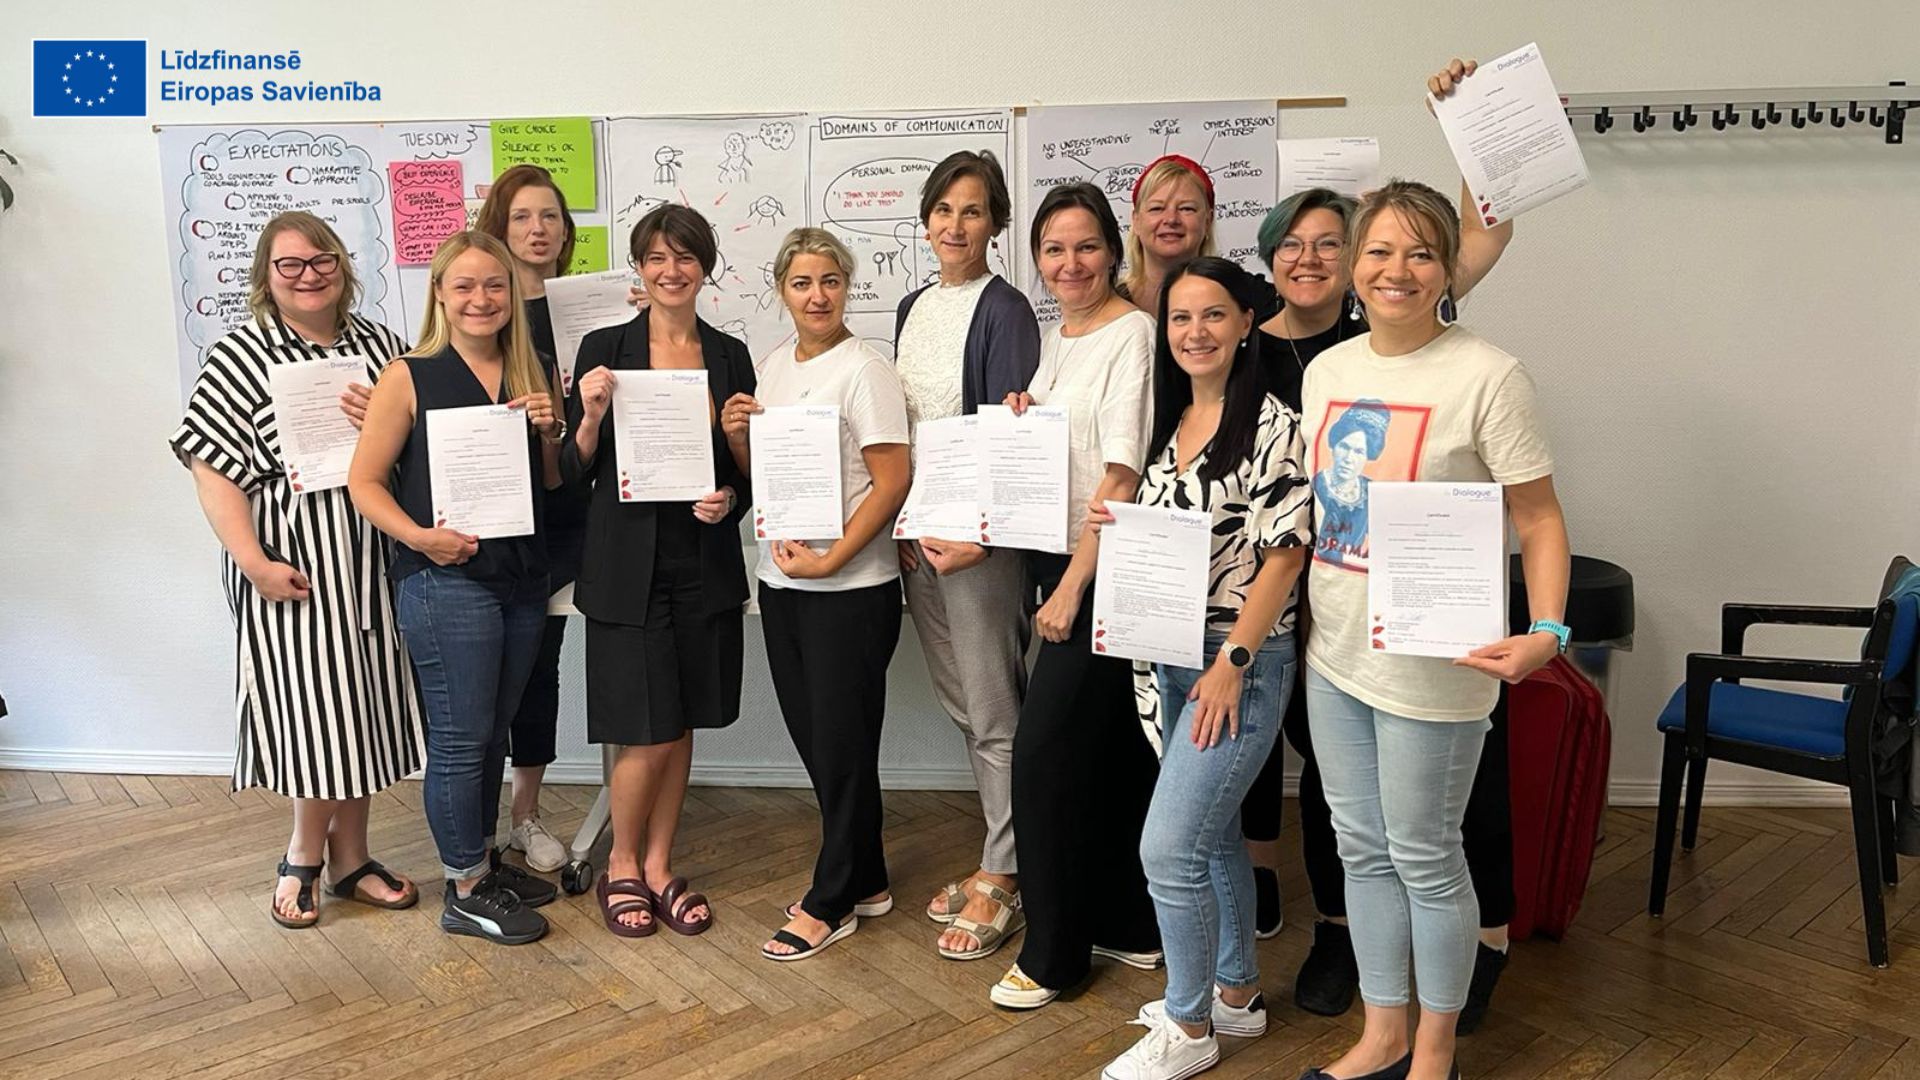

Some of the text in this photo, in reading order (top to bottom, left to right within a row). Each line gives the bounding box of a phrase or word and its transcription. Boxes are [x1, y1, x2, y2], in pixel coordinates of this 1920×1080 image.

[823, 119, 1003, 136] DOMAINS OF COMMUNICATION
[1153, 118, 1179, 128] OUT OF
[1203, 119, 1231, 131] OTHER
[499, 124, 557, 134] GIVE CHOICE
[1217, 127, 1258, 137] INTEREST
[400, 131, 460, 147] TUESDAY
[1042, 133, 1132, 152] NO UNDERSTANDING
[229, 142, 343, 160] EXPECTATIONS
[501, 140, 575, 152] SILENCE IS OK
[1045, 147, 1092, 160] OF MYSELF
[530, 156, 540, 164] TO
[1229, 160, 1251, 169] MORE
[312, 166, 361, 175] NARRATIVE
[851, 164, 931, 177] PERSONAL DOMAIN
[1223, 168, 1262, 179] CONFUSED
[312, 176, 358, 185] APPROACH
[242, 223, 265, 232] TRICK
[1452, 488, 1491, 498] Dialogue
